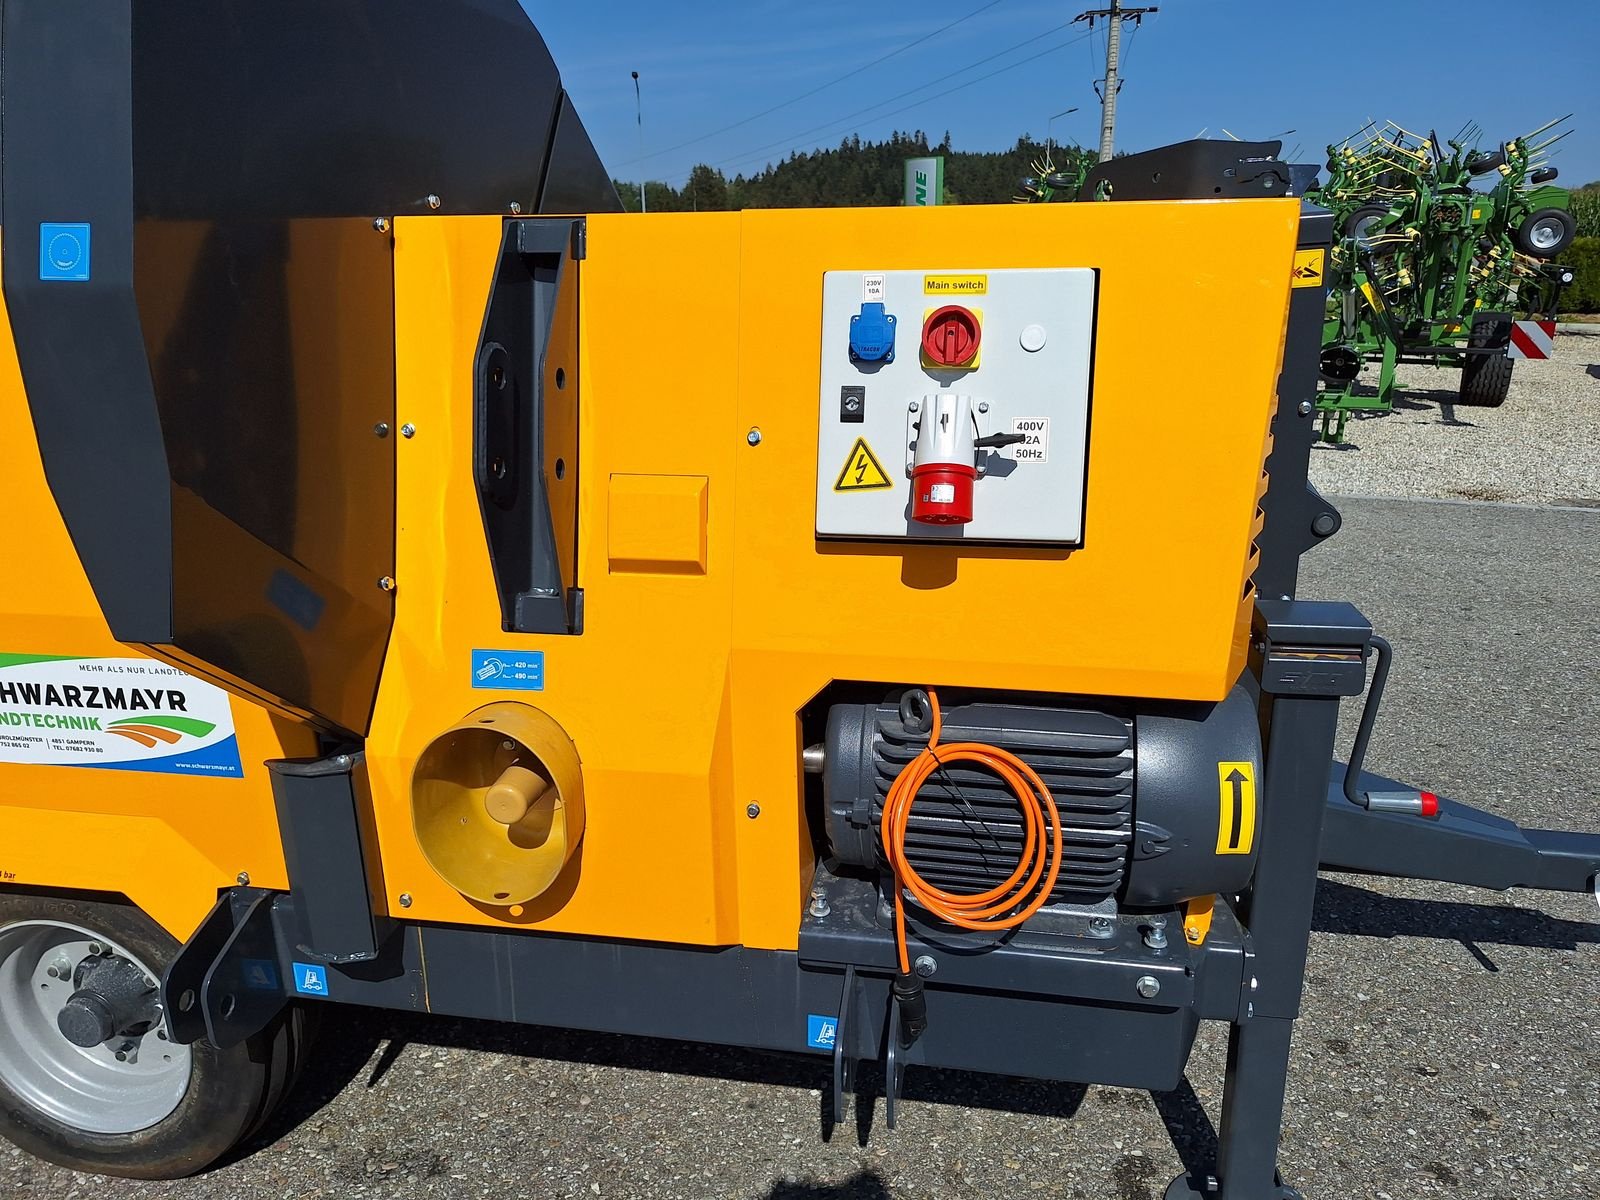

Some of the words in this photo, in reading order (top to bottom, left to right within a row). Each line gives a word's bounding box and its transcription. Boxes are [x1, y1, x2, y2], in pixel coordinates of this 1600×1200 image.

[927, 281, 950, 289] Main
[952, 281, 984, 289] switch
[1016, 421, 1044, 431] 400V
[1015, 449, 1043, 459] 50Hz
[79, 664, 104, 673] MEHR
[0, 682, 187, 711] HWARZMAYR
[0, 711, 103, 731] NDTECHNIK
[4, 870, 16, 878] bar
